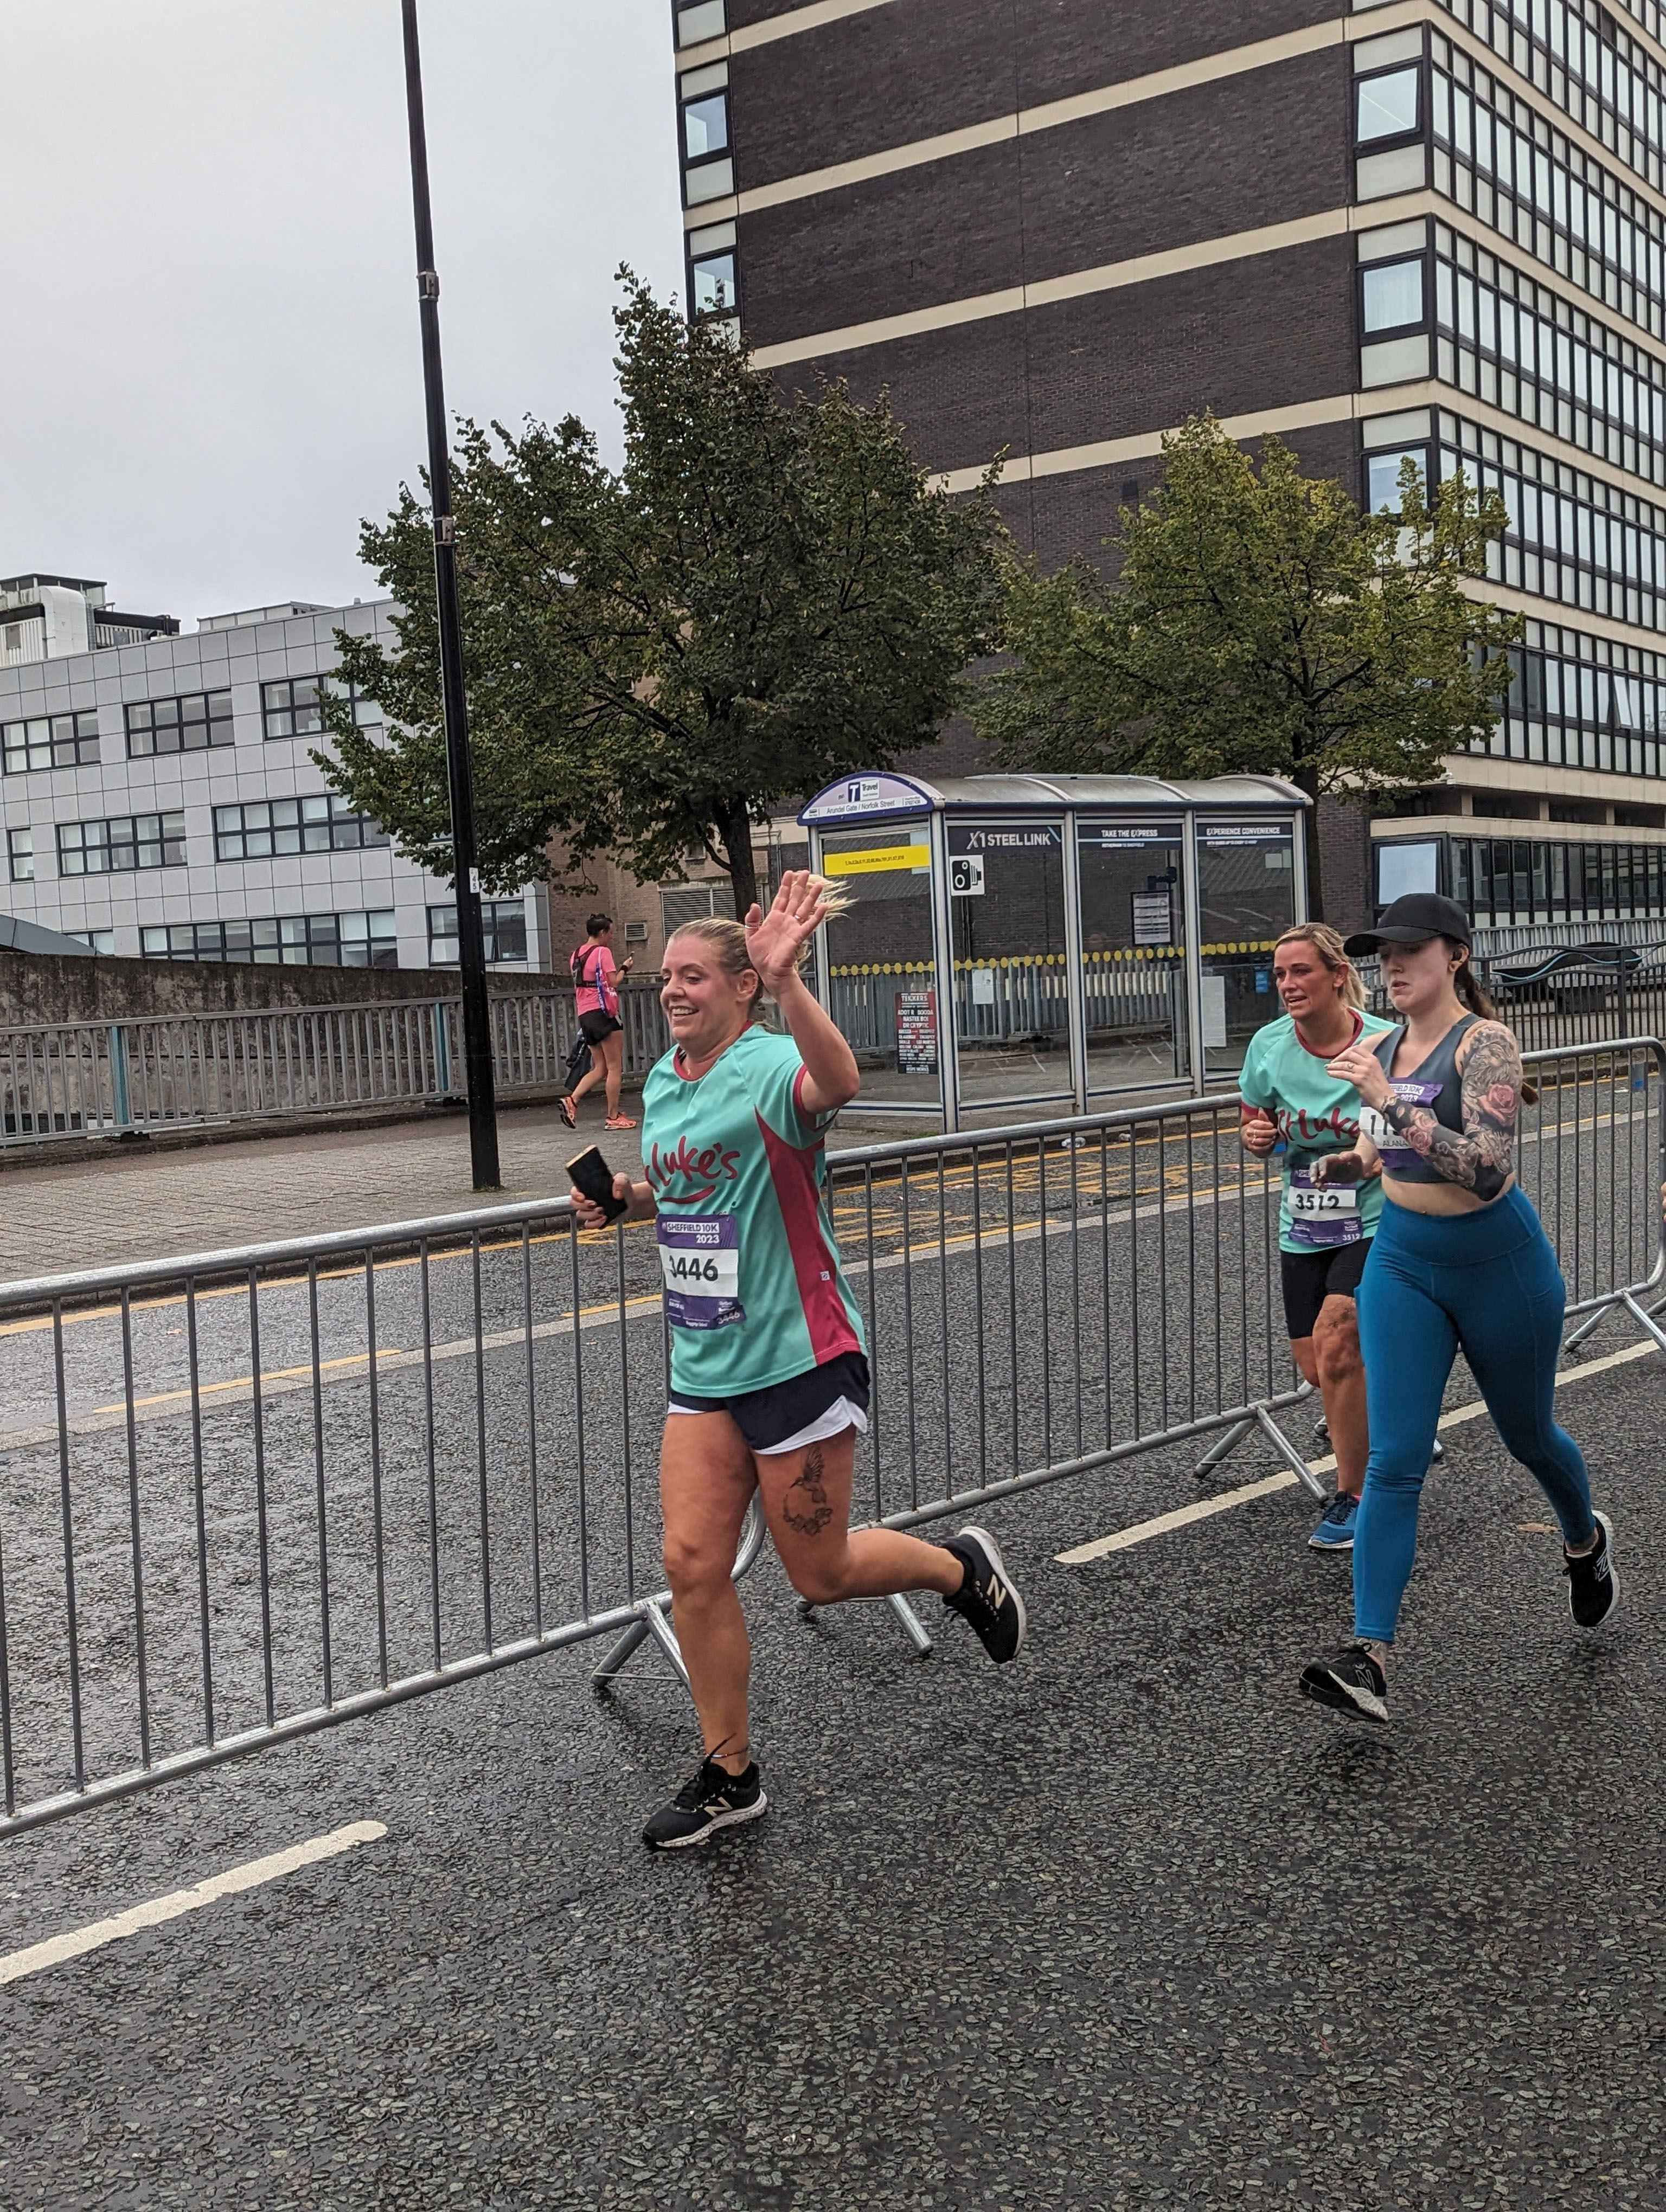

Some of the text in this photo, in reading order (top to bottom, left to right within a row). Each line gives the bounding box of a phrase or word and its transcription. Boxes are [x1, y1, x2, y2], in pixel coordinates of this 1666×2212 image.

[862, 782, 878, 791] Travel
[826, 806, 845, 814] Arundel
[880, 799, 895, 807] Street
[1101, 828, 1158, 838] TAKE THE EXPRESS
[1206, 827, 1280, 835] EXPERIENCE CONVENIENCE
[966, 831, 1051, 850] X1 STEEL LINK
[1295, 1194, 1341, 1211] 3512
[667, 1223, 718, 1232] SHEFFIELD 10K
[696, 1234, 720, 1244] 2023
[1342, 1233, 1361, 1241] 3512
[716, 1311, 741, 1324] 3446
